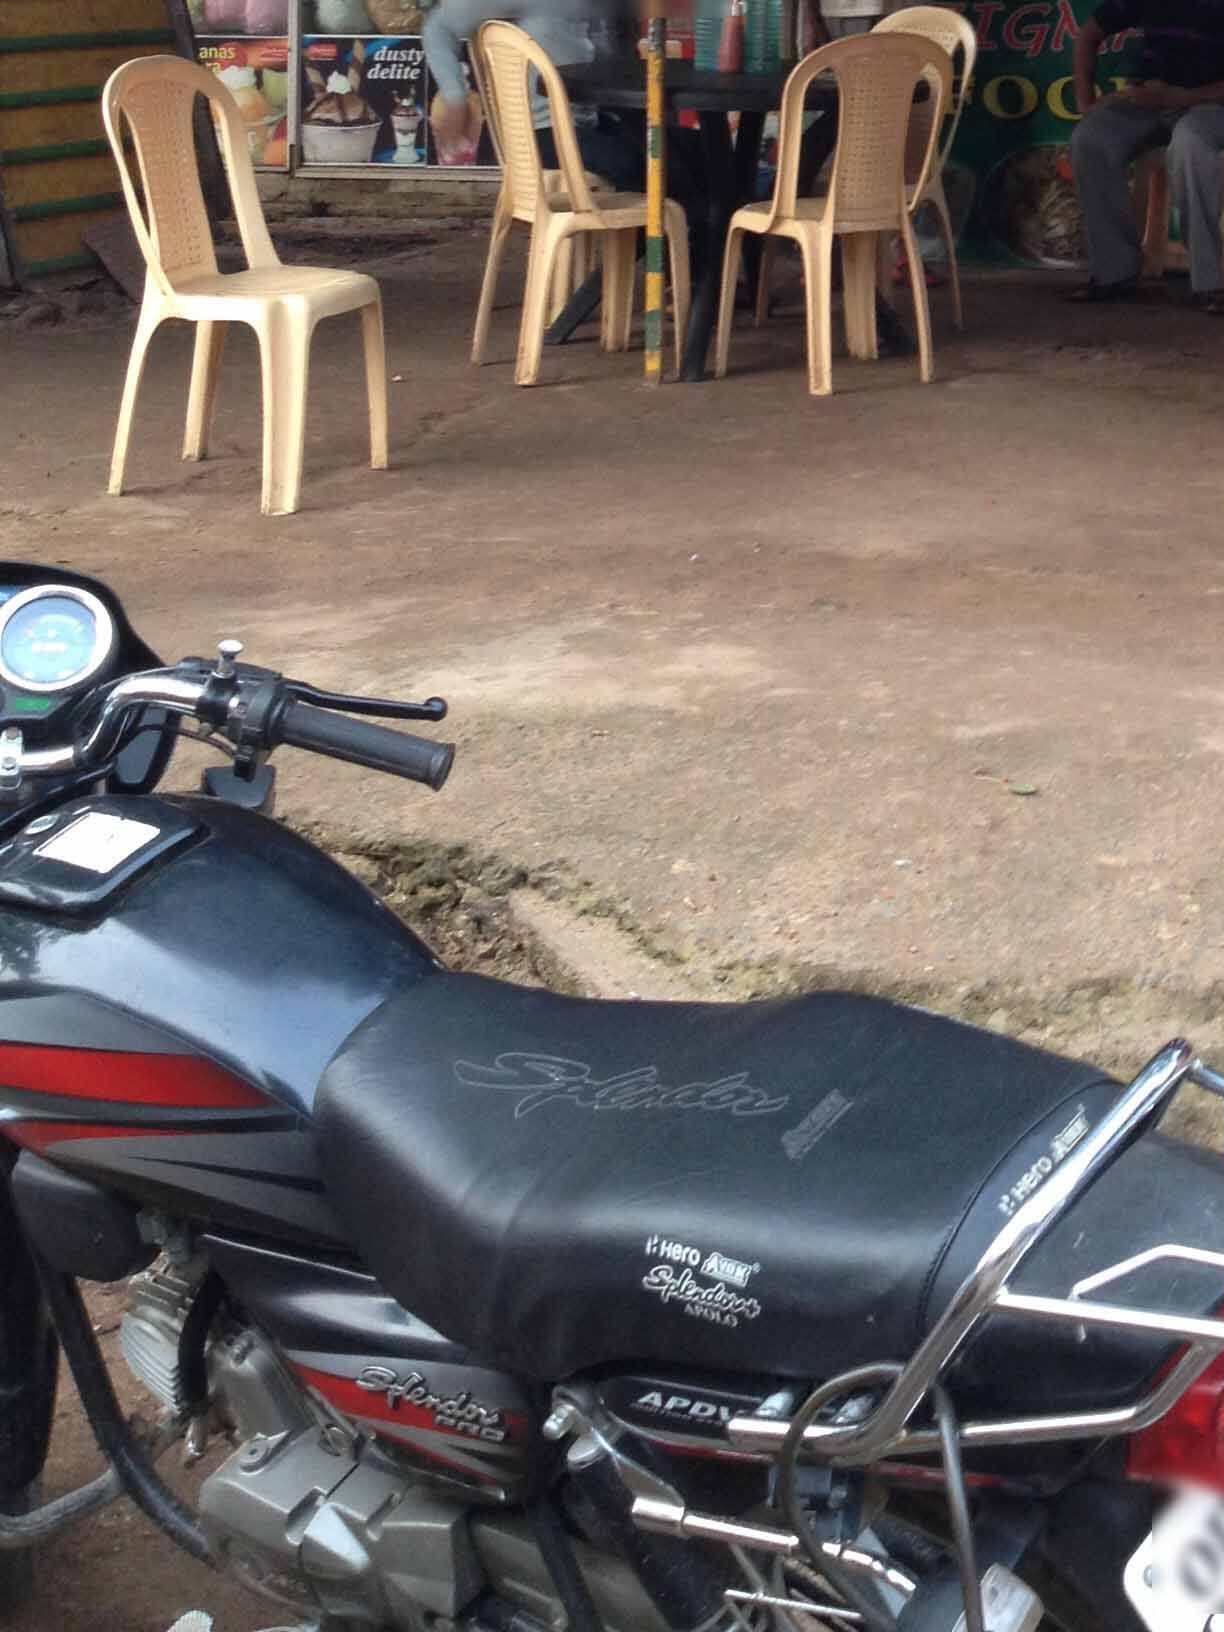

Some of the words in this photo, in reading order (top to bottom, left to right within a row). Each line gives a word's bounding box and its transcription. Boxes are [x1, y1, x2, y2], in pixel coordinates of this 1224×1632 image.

[373, 45, 425, 64] dusty
[367, 64, 421, 80] delite
[659, 1239, 701, 1267] Hero
[355, 1365, 500, 1427] Splendor
